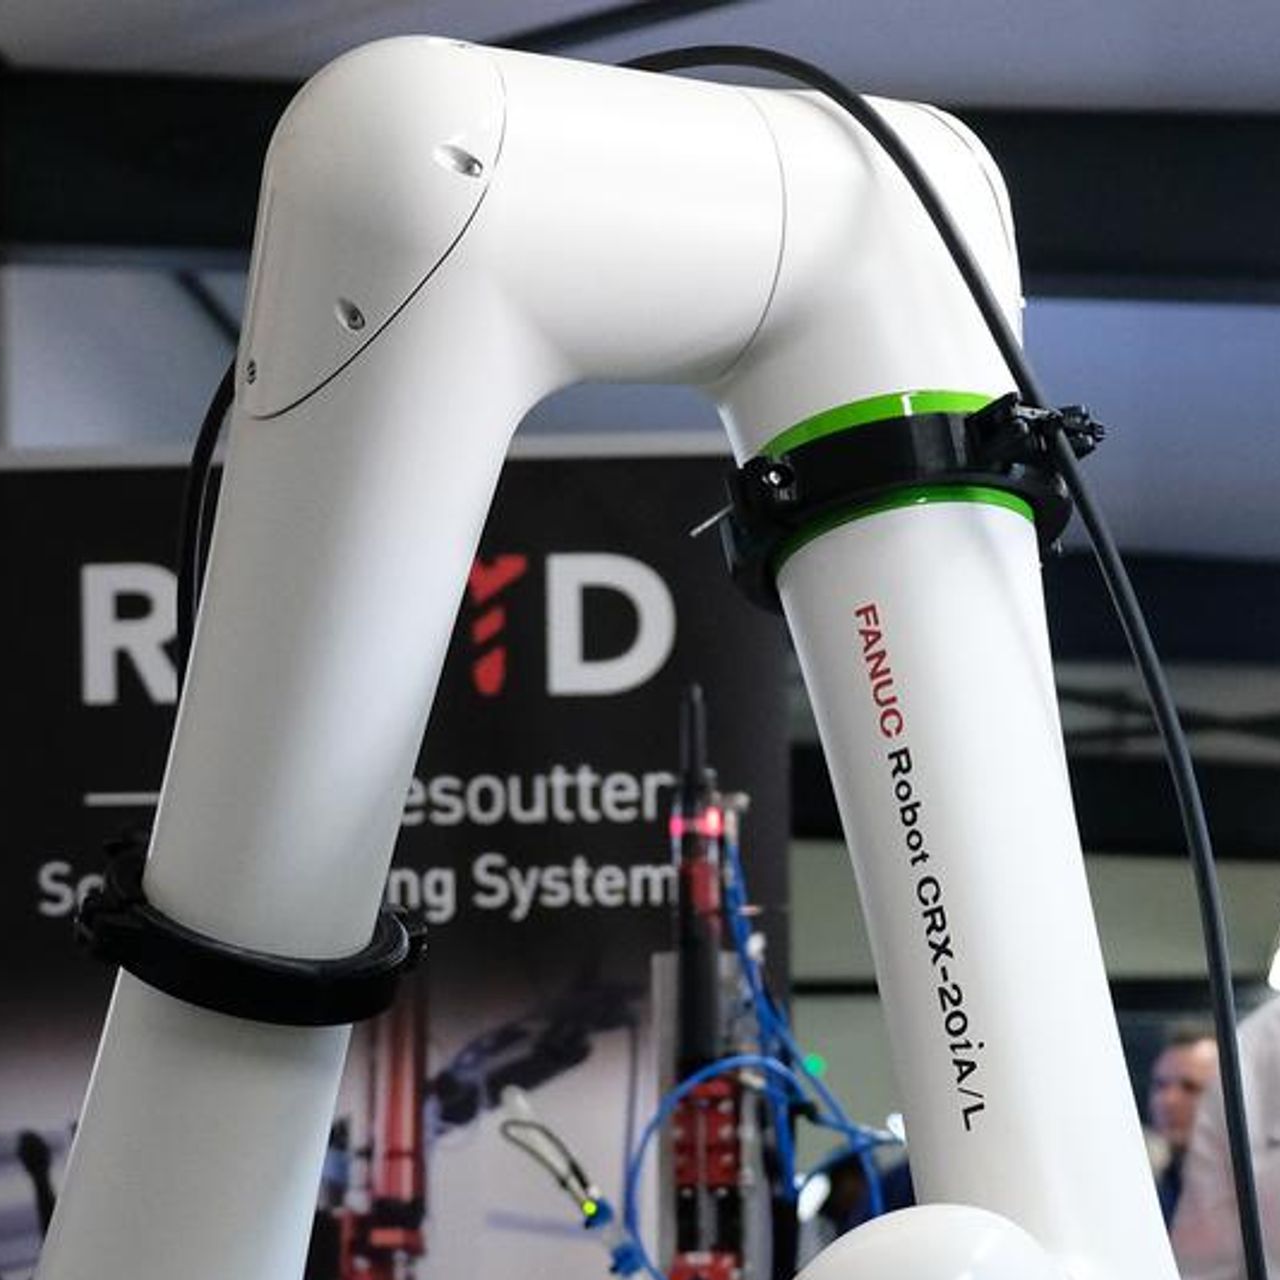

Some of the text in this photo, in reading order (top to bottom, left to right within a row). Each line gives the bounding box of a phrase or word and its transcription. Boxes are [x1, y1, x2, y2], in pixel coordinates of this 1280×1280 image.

[401, 764, 675, 827] esoutter
[854, 603, 986, 1132] FANUC Robot CRX-20iA/L
